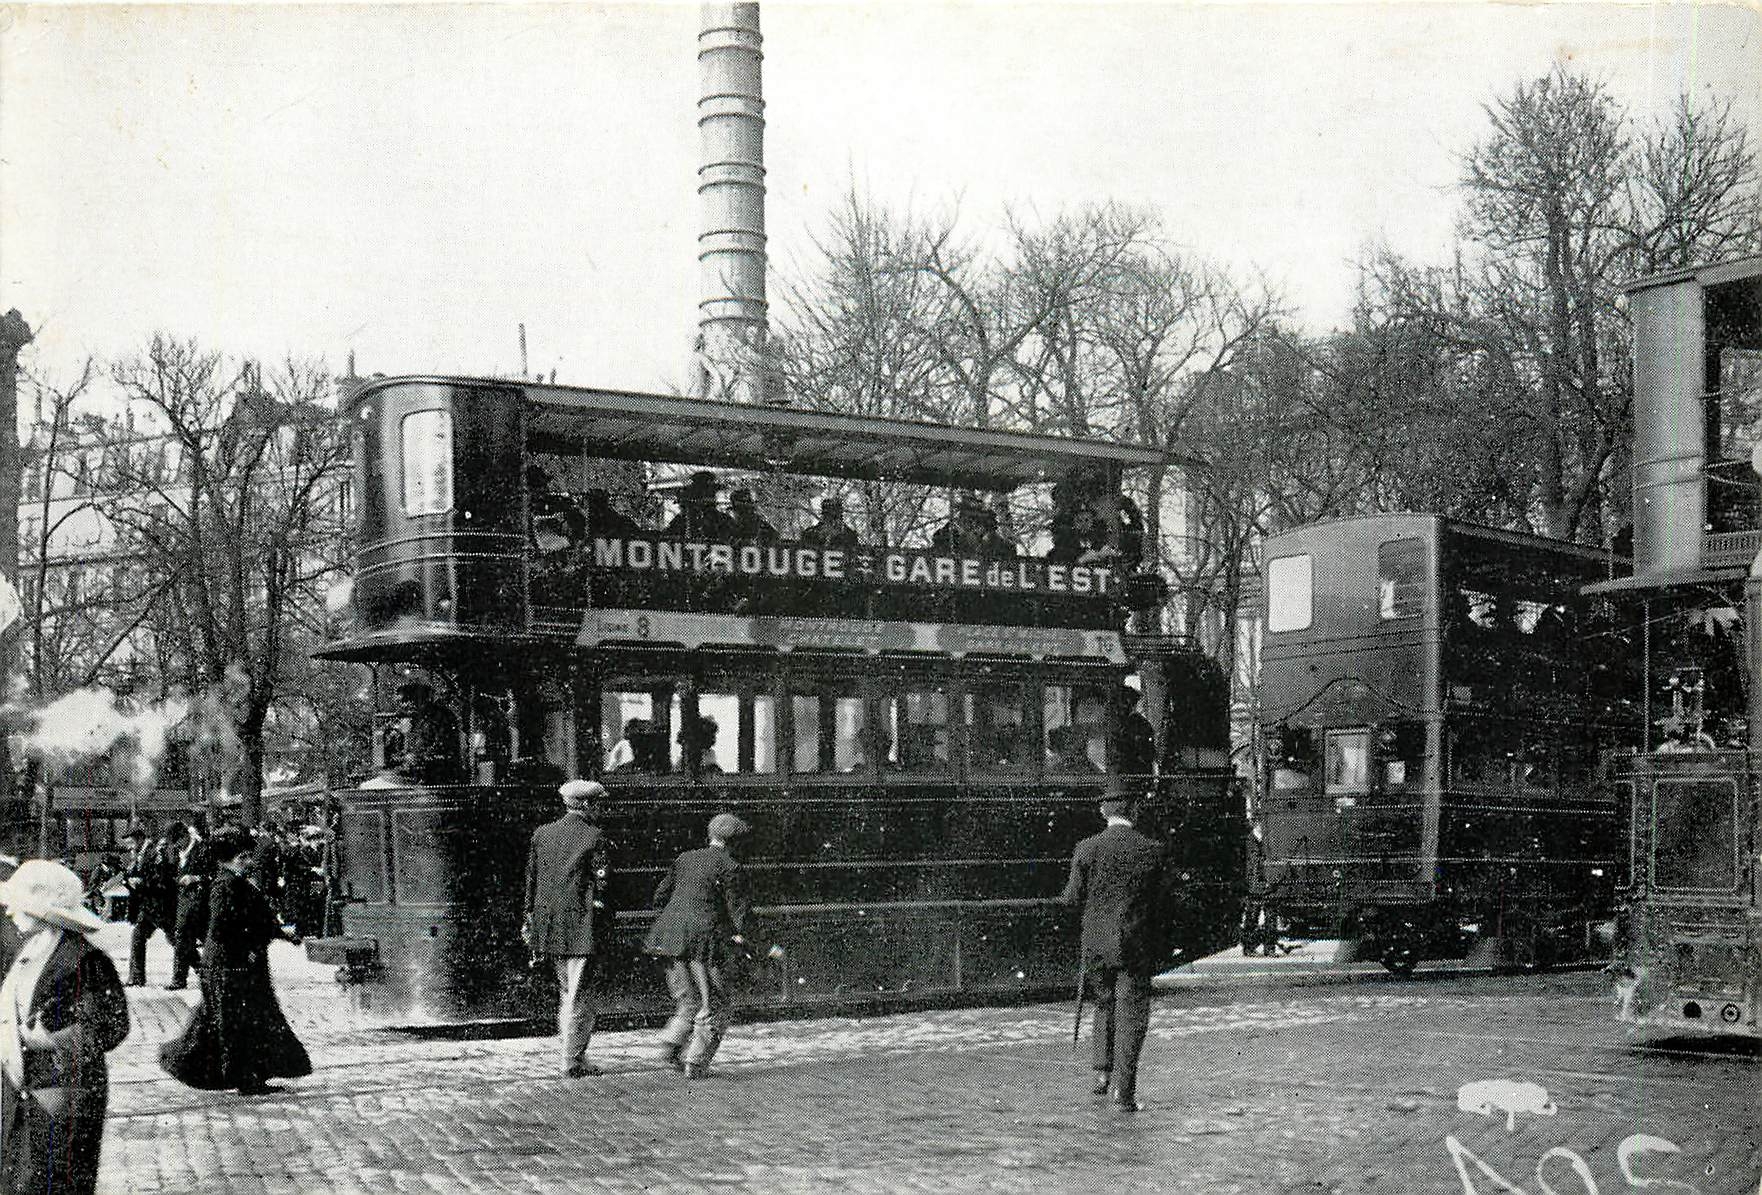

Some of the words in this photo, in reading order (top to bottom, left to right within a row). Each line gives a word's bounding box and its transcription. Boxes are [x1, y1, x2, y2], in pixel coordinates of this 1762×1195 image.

[593, 537, 846, 579] MONTROUGE
[886, 553, 981, 587] GARE
[636, 615, 650, 638] 8
